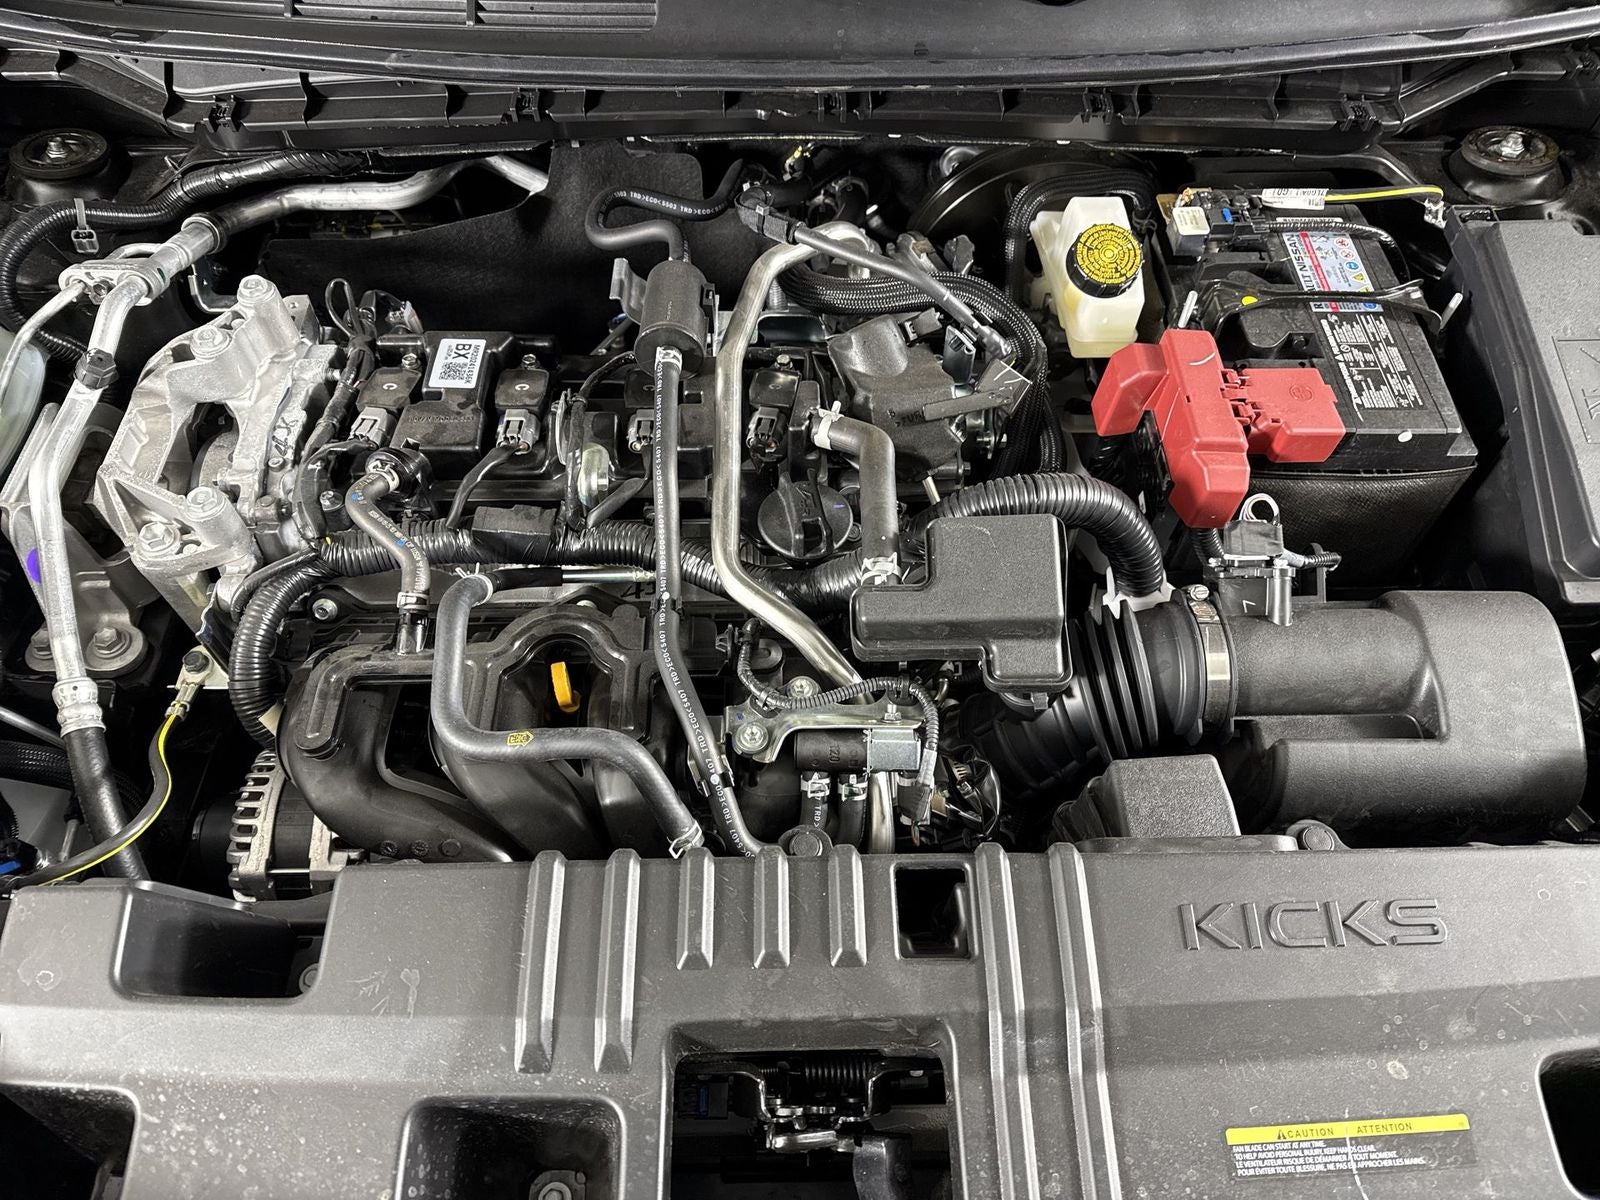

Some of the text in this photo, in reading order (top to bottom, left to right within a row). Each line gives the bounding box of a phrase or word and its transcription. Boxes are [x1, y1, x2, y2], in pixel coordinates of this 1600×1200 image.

[1286, 234, 1307, 272] NISSAN
[452, 343, 472, 360] BX
[655, 446, 664, 508] TRD>ECO<5407
[658, 514, 667, 573] TRD>ECO<5407
[660, 630, 681, 687] TRD>ECO<5407
[677, 689, 709, 754] TRD>ECO<5407
[1177, 899, 1449, 951] KICKS
[1287, 1122, 1413, 1138] CAUTION ATTENTION
[1243, 1152, 1257, 1160] HELP
[1245, 1144, 1262, 1152] BLADE
[1262, 1143, 1275, 1151] CAN
[1275, 1142, 1291, 1150] START
[1235, 1161, 1244, 1169] LE
[1305, 1156, 1315, 1164] DE
[1237, 1168, 1256, 1176] POUR
